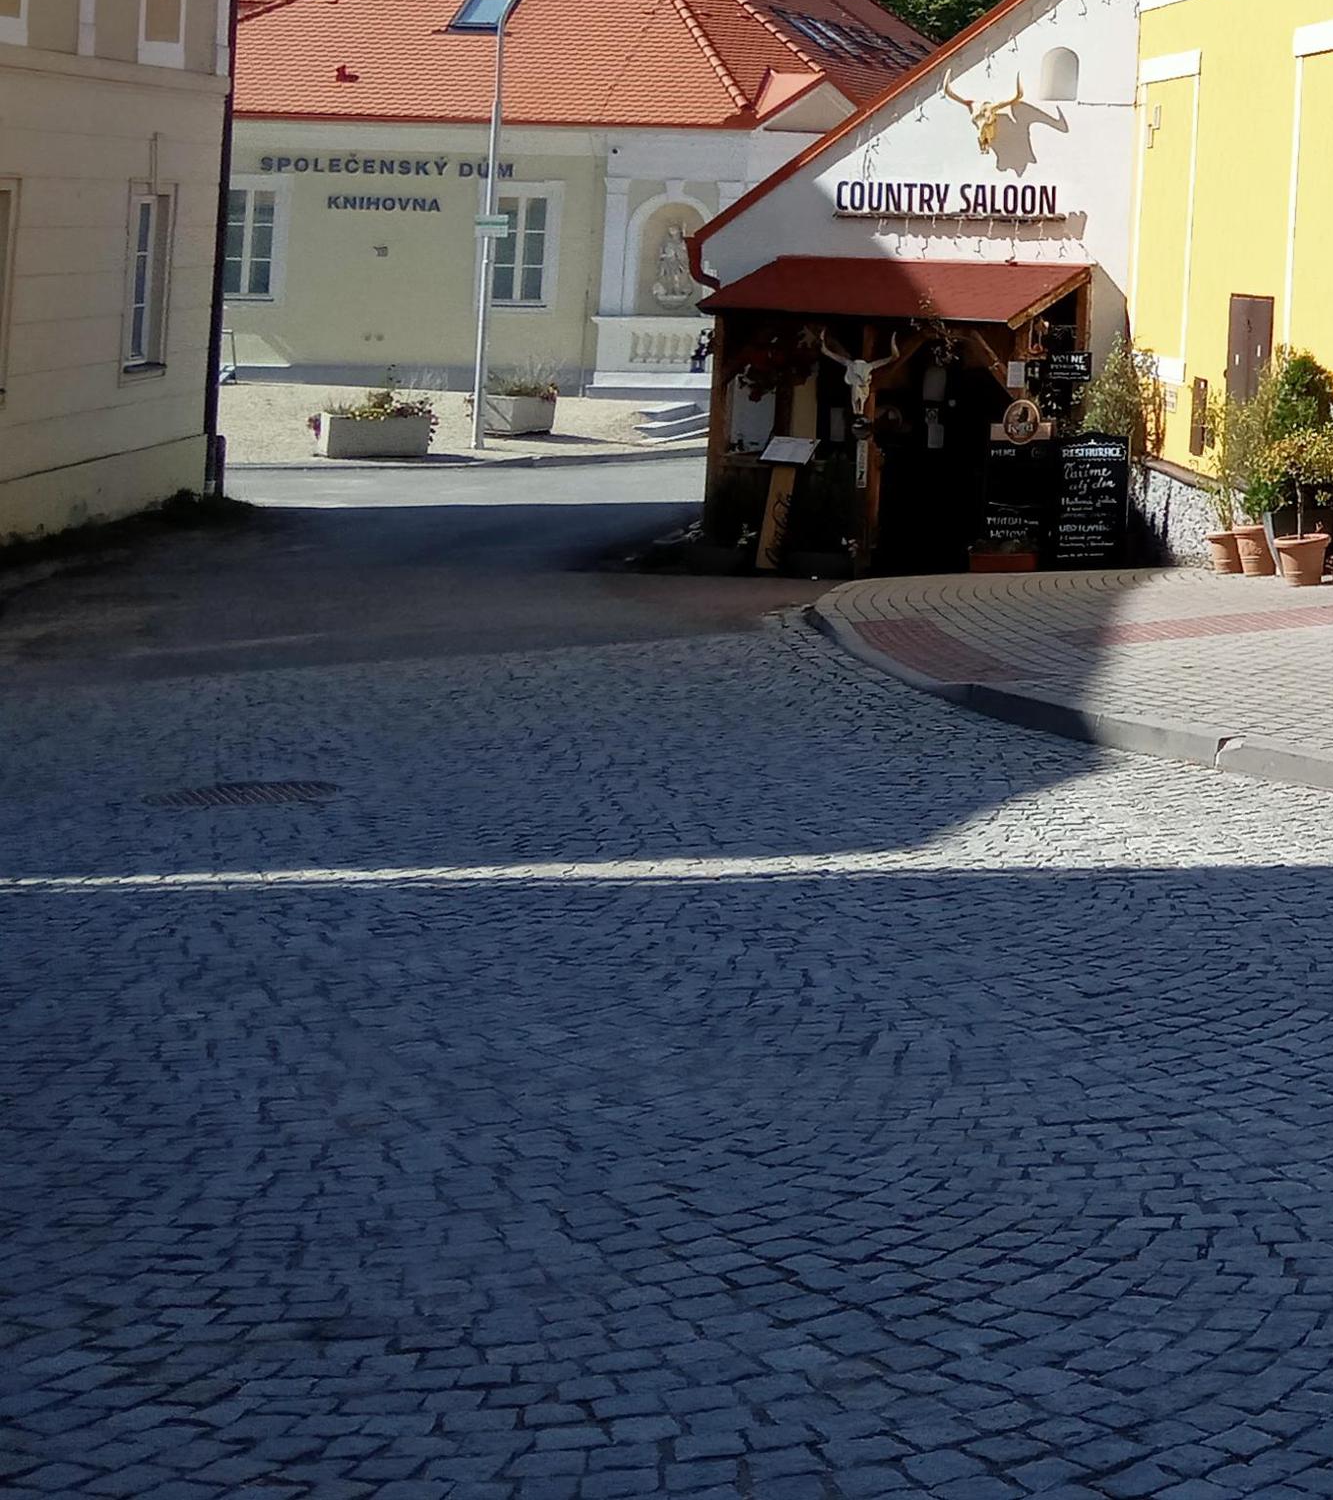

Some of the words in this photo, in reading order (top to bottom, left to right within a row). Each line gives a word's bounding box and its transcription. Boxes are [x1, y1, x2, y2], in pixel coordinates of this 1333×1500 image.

[260, 152, 449, 177] SPOLEČENSKÝ
[327, 195, 442, 213] KNIHOVNA
[836, 180, 950, 213] COUNTRY
[959, 183, 1057, 215] SALOON
[1061, 447, 1122, 458] RESTAURACE
